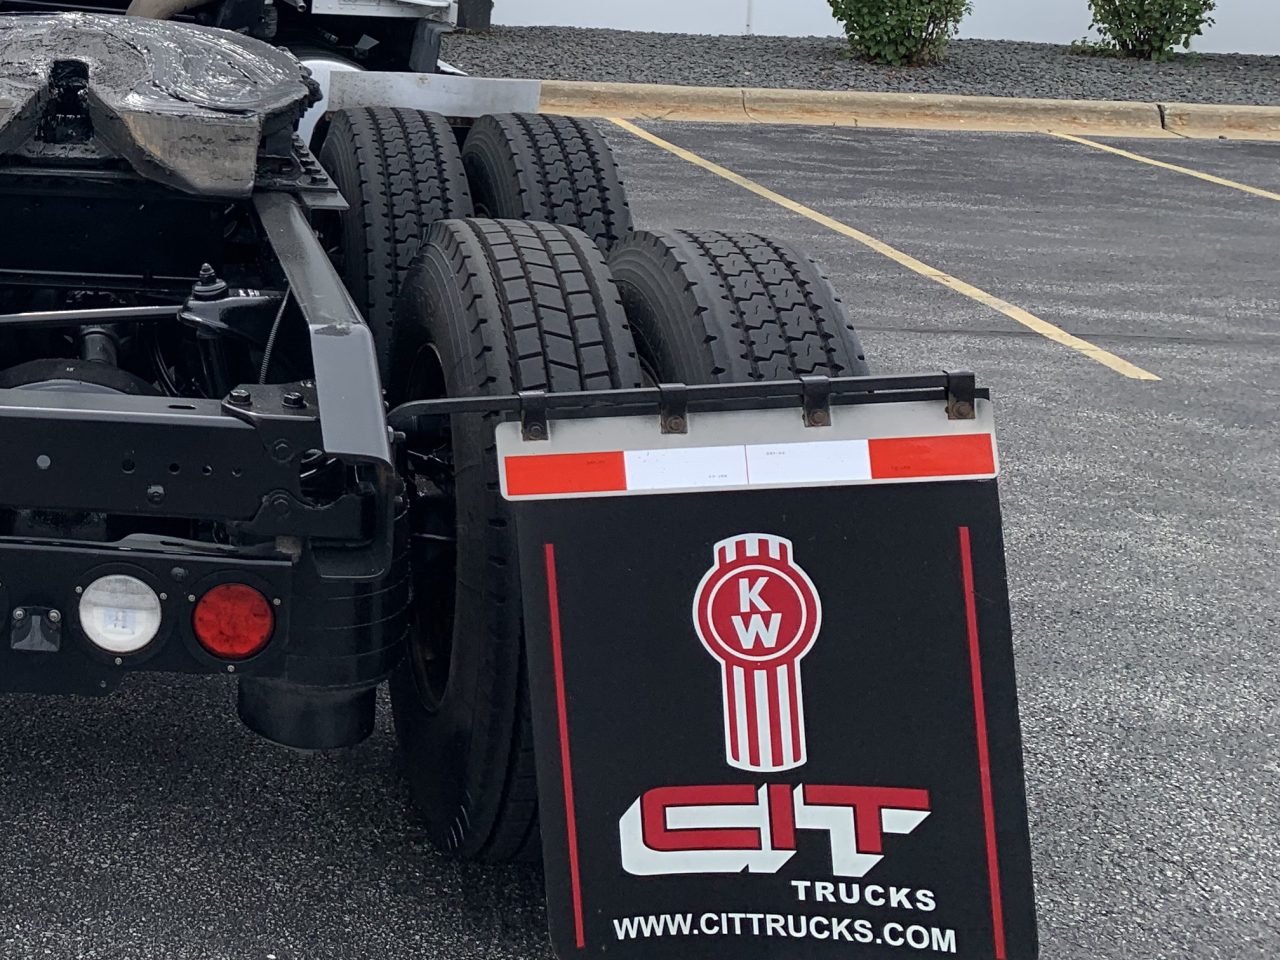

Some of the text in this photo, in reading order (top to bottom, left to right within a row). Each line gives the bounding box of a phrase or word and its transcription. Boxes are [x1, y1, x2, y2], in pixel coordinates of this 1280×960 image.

[738, 576, 771, 612] K
[731, 613, 783, 650] W
[619, 782, 932, 878] CIT
[790, 880, 937, 912] TRUCKS
[613, 912, 957, 954] WWW.CITTRUCKS.COM
